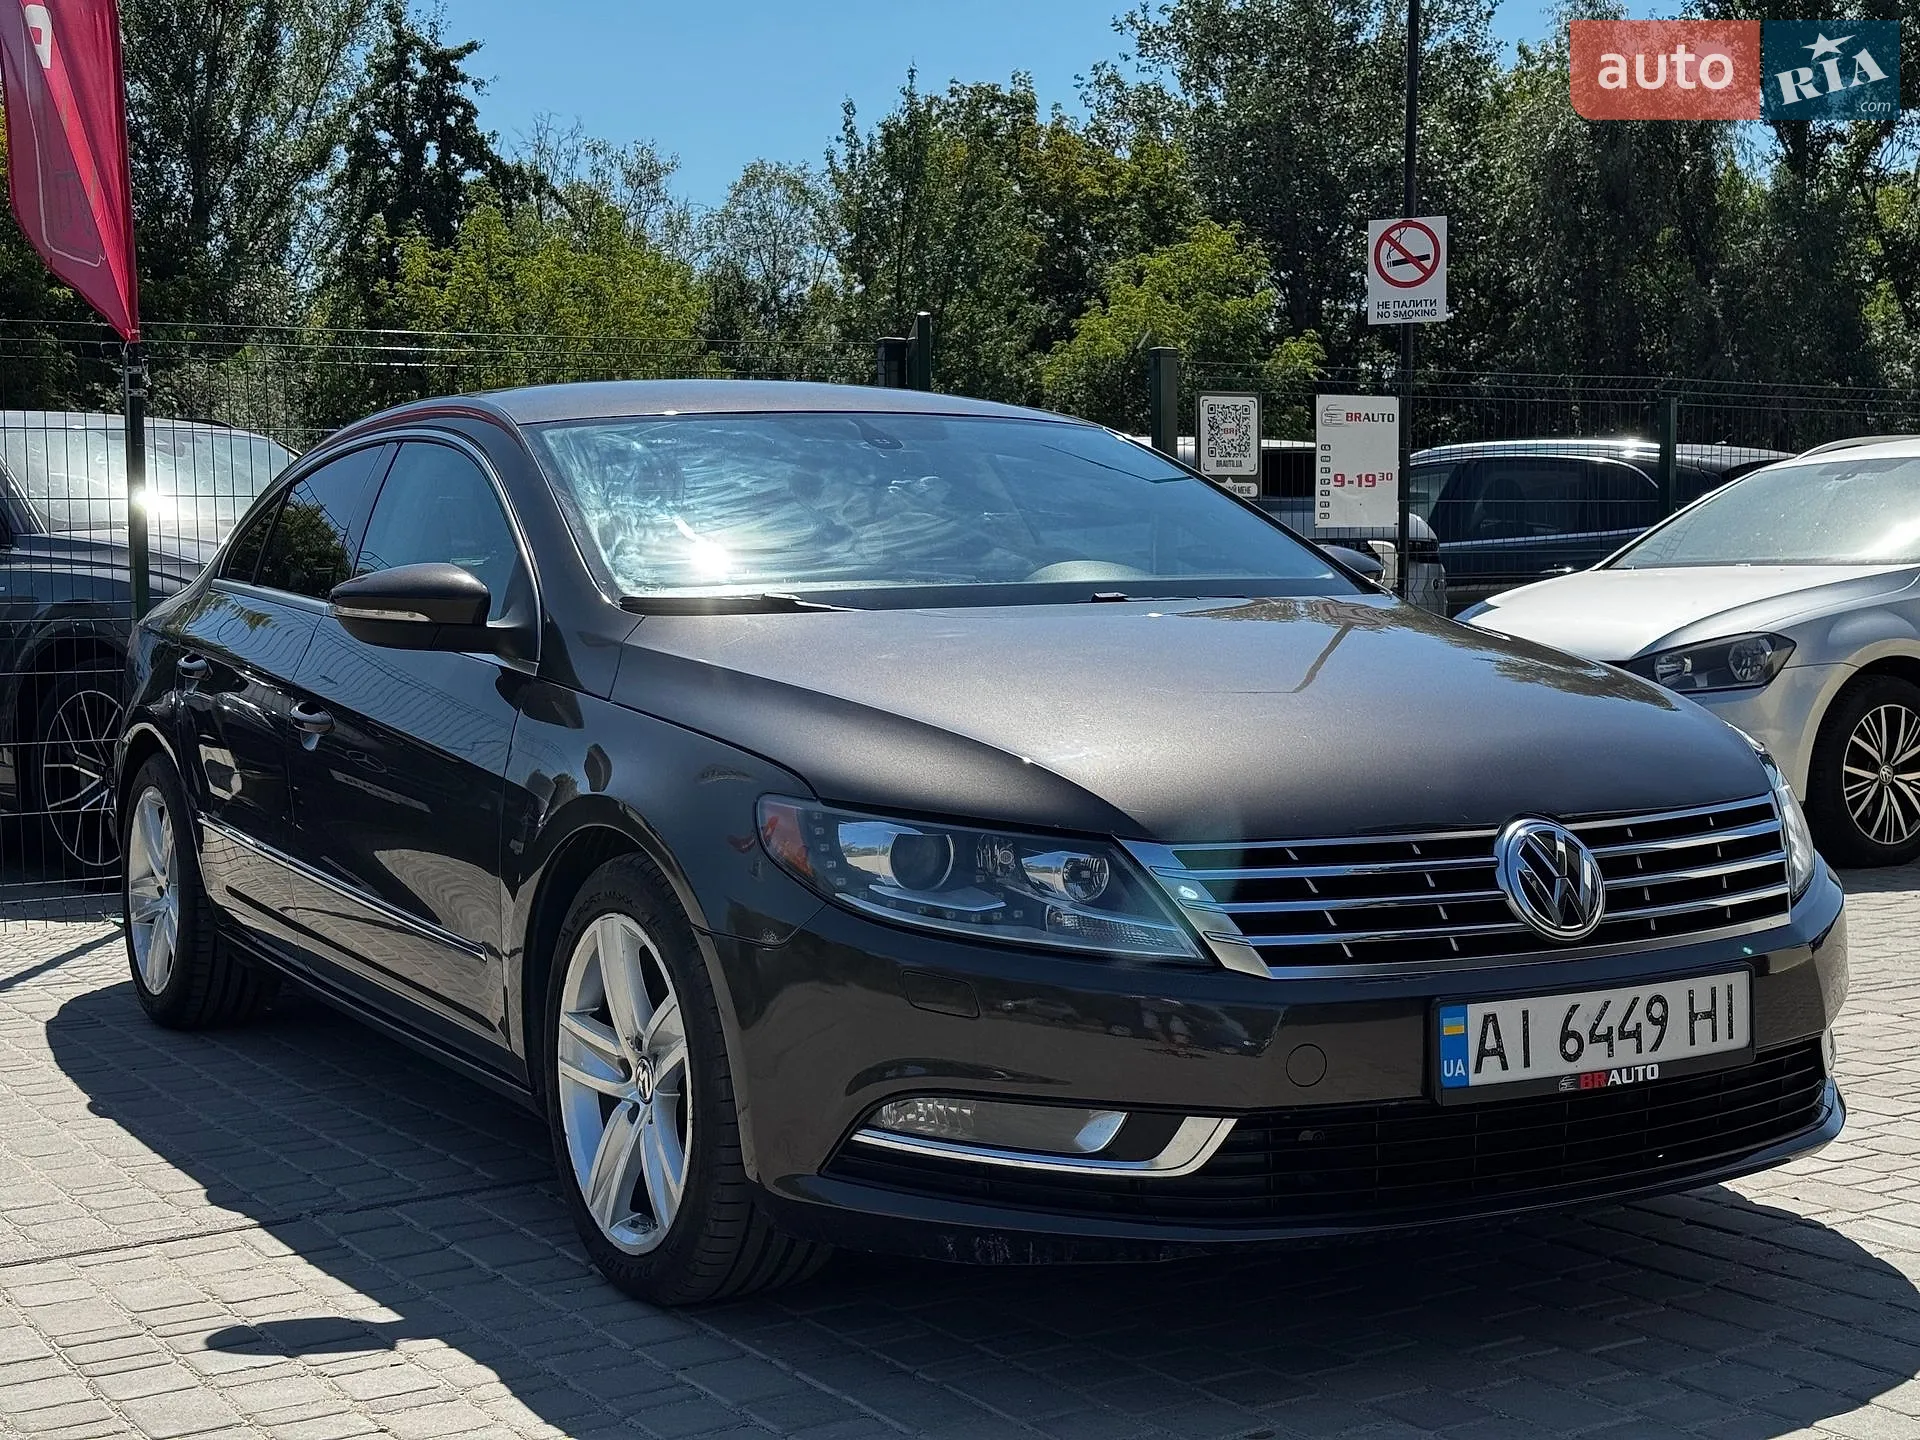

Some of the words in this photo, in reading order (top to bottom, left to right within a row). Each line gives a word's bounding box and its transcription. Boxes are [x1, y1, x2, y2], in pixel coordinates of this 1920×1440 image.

[1377, 301, 1390, 310] НЕ
[1393, 299, 1437, 309] ПАЛИТИ
[1377, 311, 1391, 319] NO
[1393, 309, 1437, 318] SMOKING
[1346, 412, 1395, 423] BRAUTO
[1474, 1009, 1531, 1074] AI
[1559, 994, 1669, 1063] 6449
[1688, 983, 1734, 1047] HI
[1443, 1057, 1466, 1078] UA
[1579, 1063, 1659, 1090] BRAUTO
